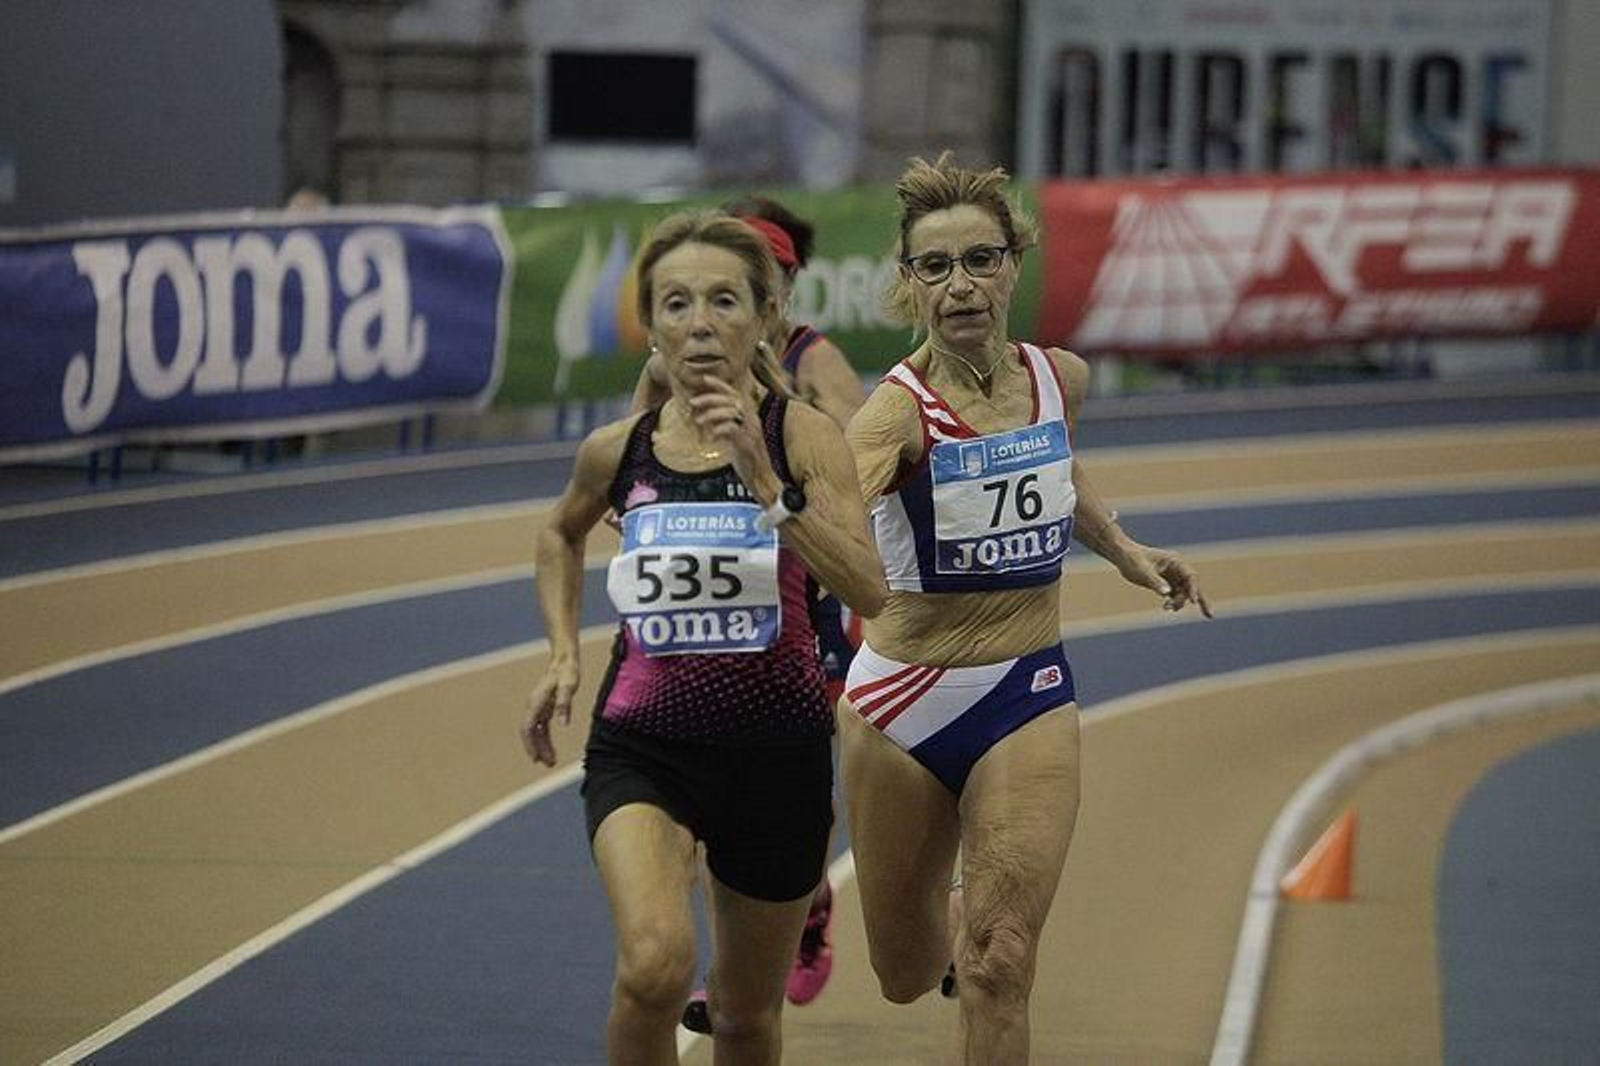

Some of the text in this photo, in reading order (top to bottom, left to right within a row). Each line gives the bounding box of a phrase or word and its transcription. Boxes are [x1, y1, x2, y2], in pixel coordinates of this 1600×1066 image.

[1258, 178, 1576, 298] RFEA
[991, 433, 1051, 459] LOTERÍAS
[666, 514, 747, 531] LOTERÍAS
[983, 473, 1042, 528] 76
[636, 553, 743, 604] 535
